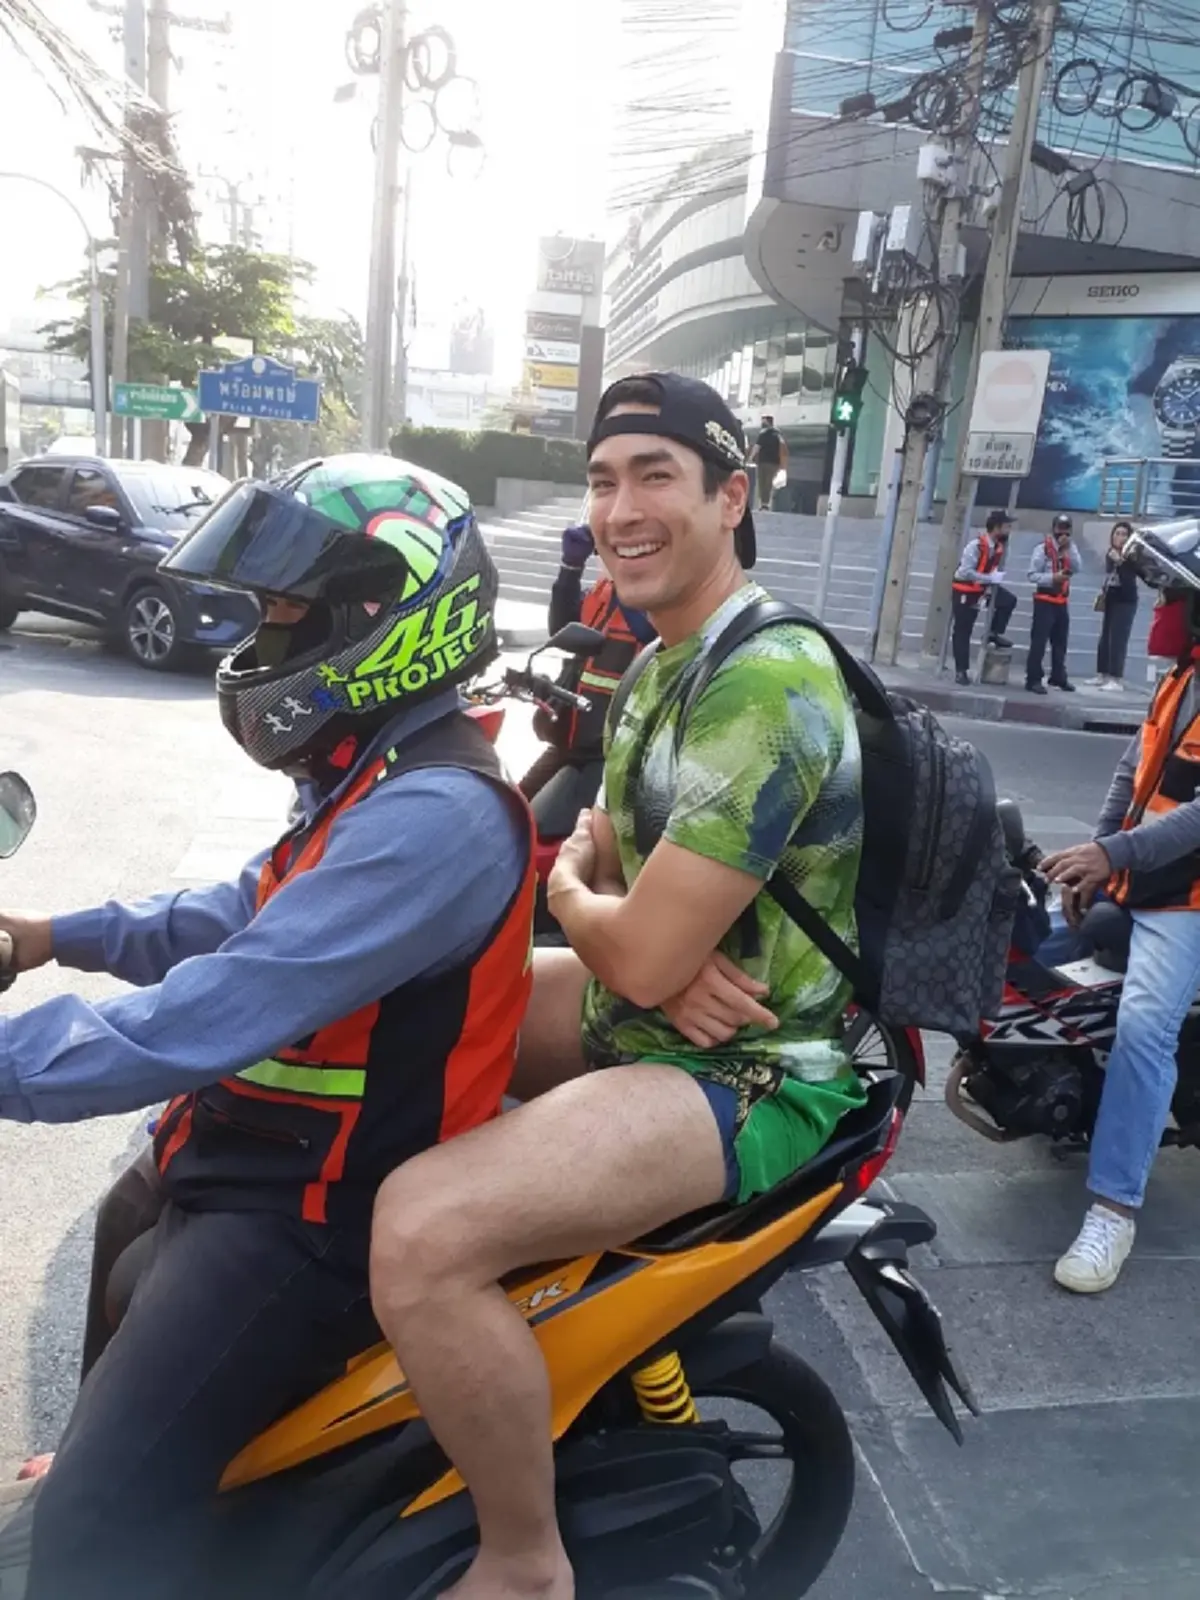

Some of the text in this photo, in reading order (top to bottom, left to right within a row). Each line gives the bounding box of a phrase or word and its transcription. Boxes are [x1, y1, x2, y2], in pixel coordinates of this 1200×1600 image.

[1087, 284, 1140, 298] SEIKO
[347, 611, 491, 707] PROJECT
[355, 573, 480, 678] 46
